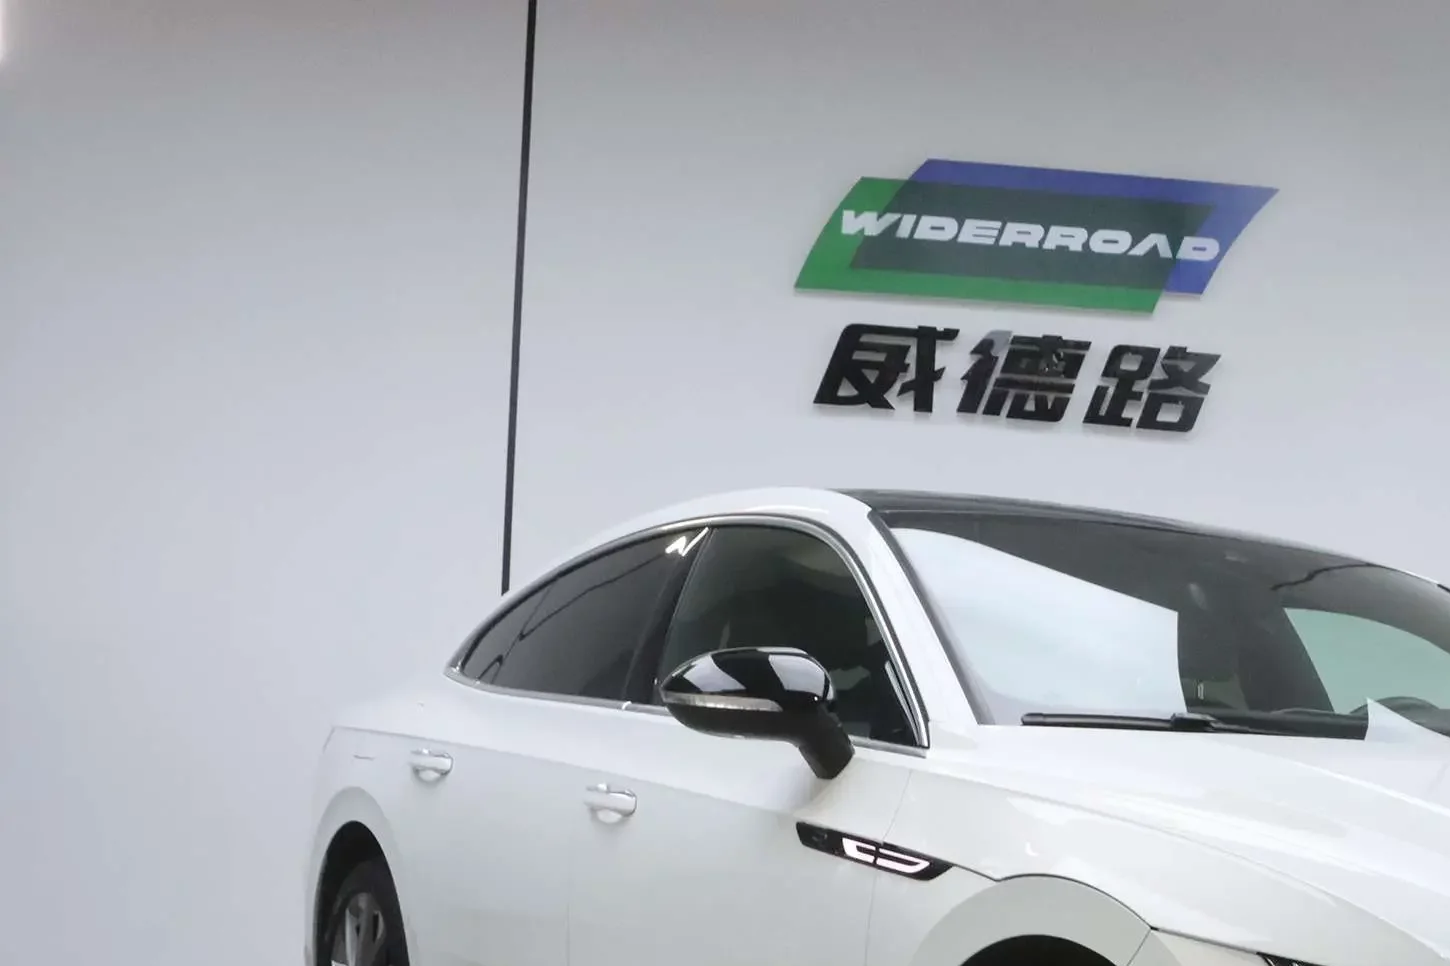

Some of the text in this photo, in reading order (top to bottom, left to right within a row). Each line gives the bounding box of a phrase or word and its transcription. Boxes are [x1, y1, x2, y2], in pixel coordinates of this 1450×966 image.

[841, 209, 1221, 262] WIDERROAD
[813, 323, 1222, 432] 威德路
